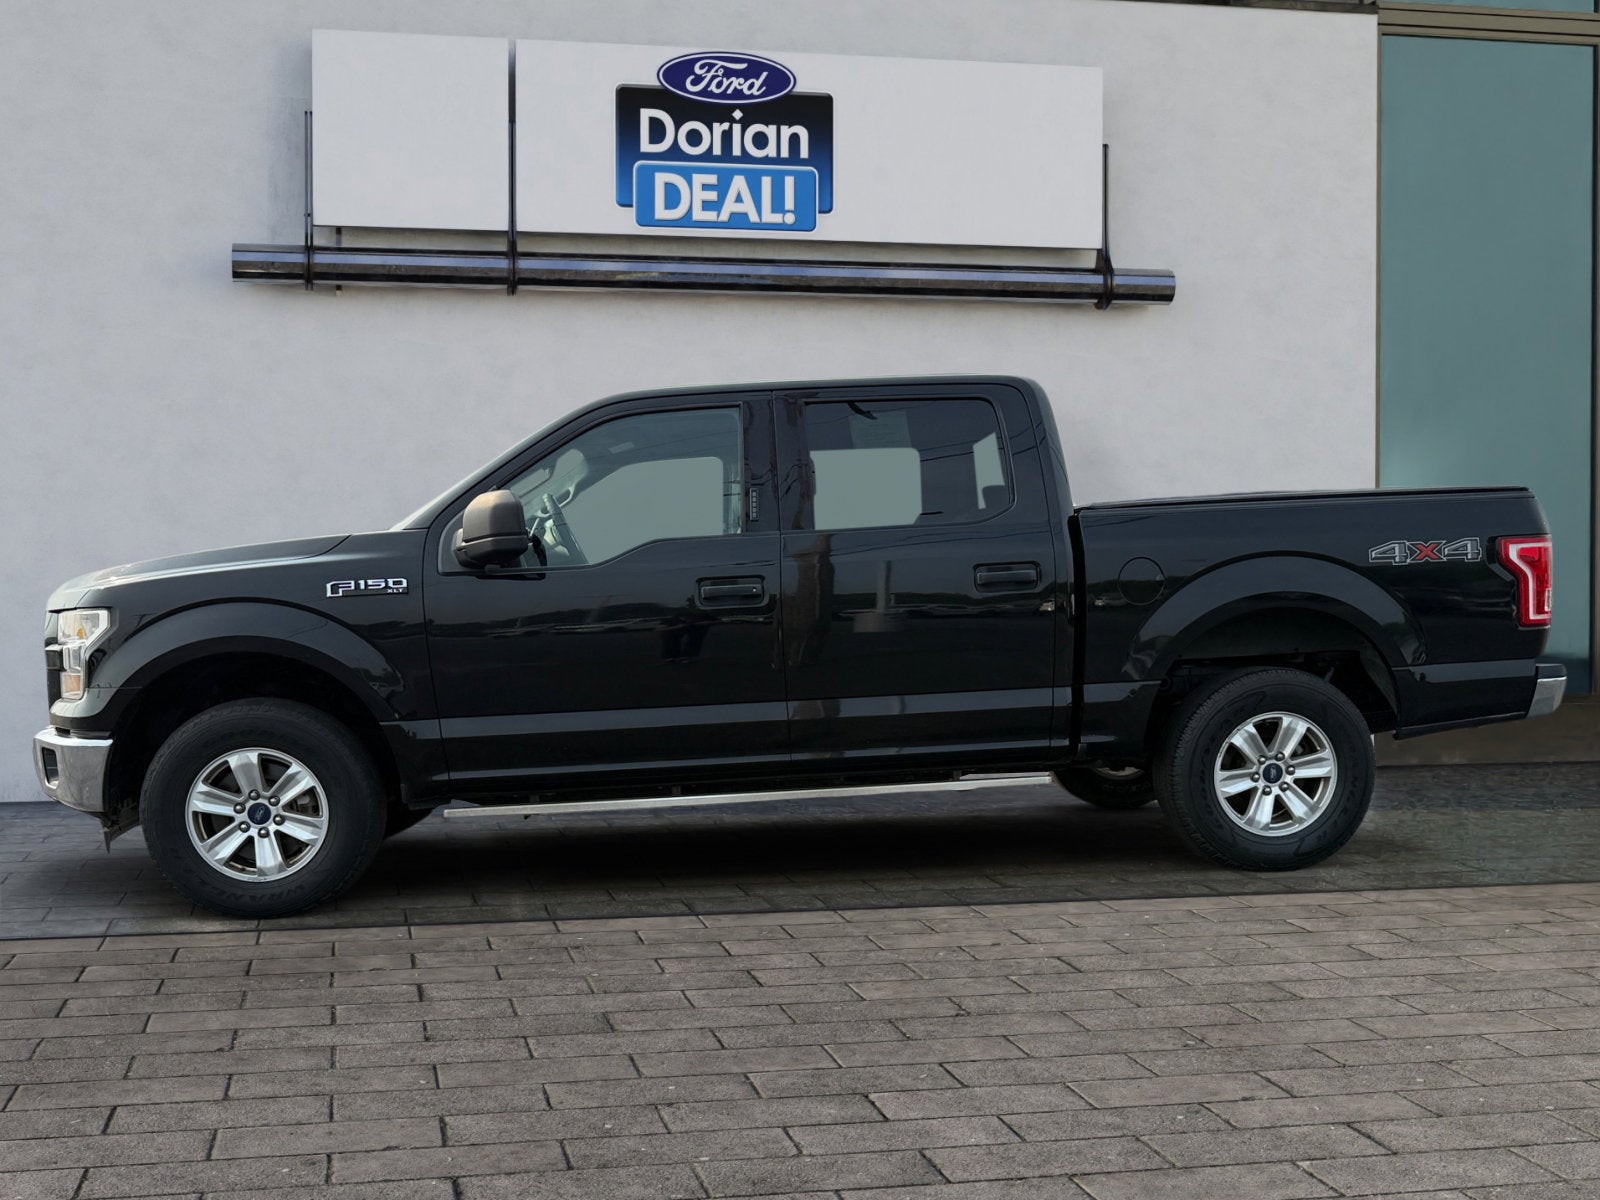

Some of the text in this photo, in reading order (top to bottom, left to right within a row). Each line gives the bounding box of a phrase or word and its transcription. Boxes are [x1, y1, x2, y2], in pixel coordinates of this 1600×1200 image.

[685, 59, 769, 96] Ford
[639, 108, 809, 159] Dorian
[654, 172, 796, 225] DEAL!
